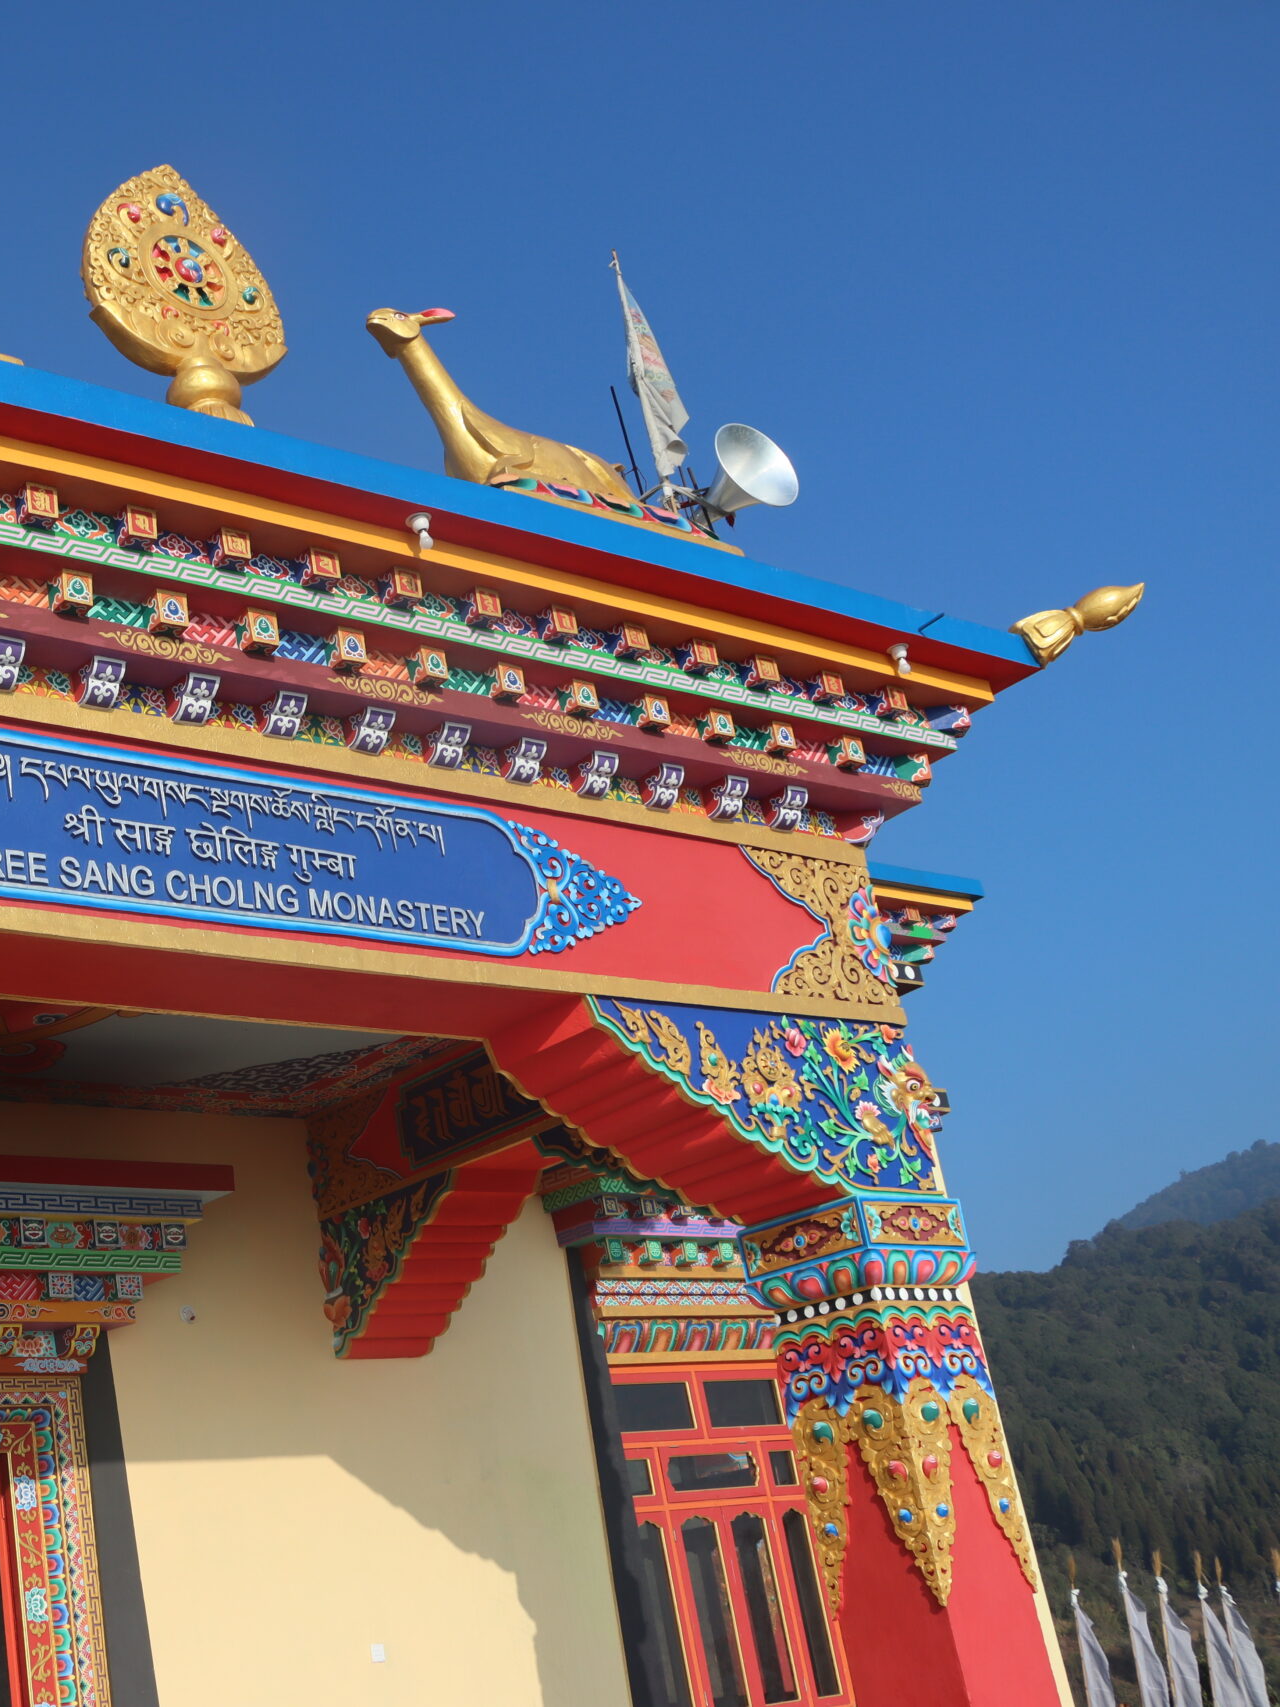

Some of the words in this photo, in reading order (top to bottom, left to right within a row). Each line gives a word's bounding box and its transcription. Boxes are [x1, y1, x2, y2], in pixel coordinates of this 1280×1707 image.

[63, 804, 106, 846] श्री
[283, 843, 358, 884] गुम्बा
[60, 855, 156, 897] SANG
[165, 869, 300, 914] CHOLNG
[307, 887, 486, 938] MONASTERY
